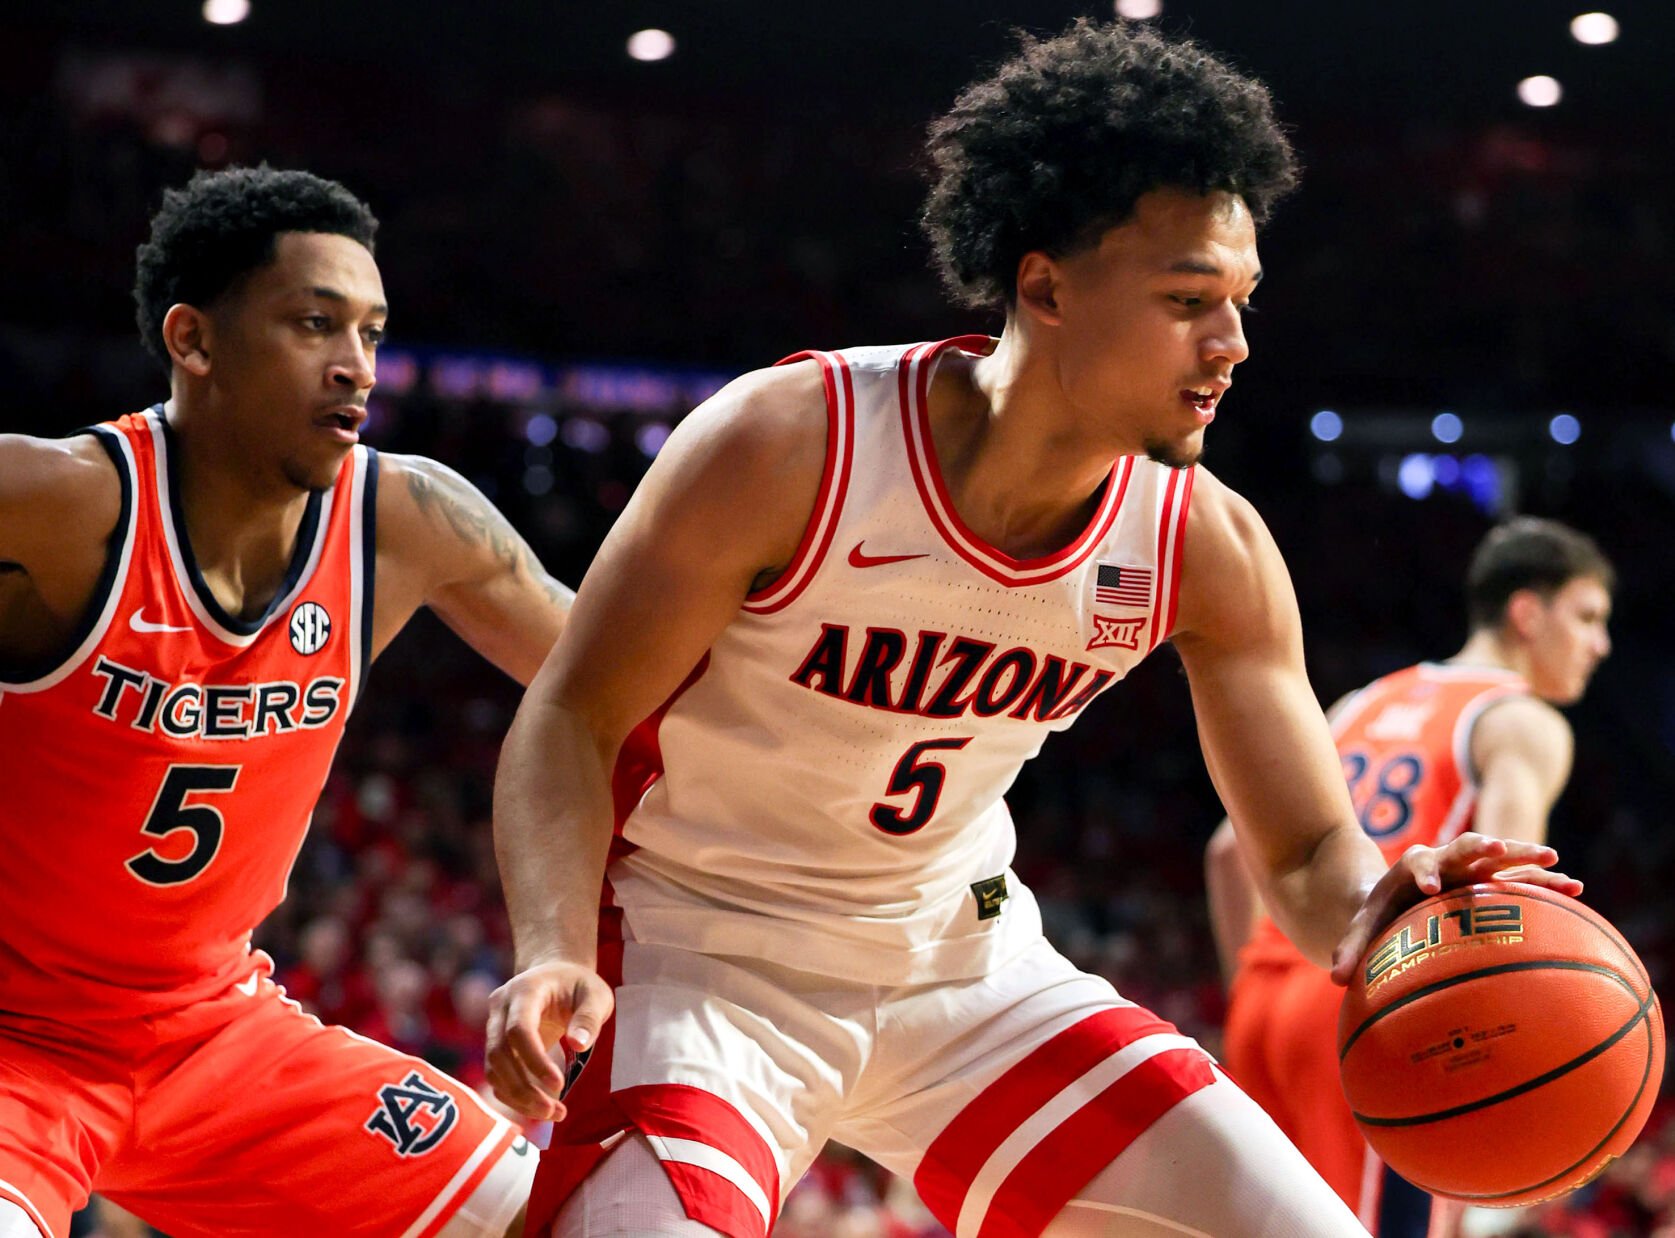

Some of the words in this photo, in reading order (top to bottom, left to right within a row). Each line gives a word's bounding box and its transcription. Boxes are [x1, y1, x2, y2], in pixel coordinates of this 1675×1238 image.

[290, 603, 331, 654] SEC
[789, 623, 1115, 722] ARIZONA
[1088, 616, 1145, 649] XII
[92, 655, 345, 740] TIGERS
[124, 764, 243, 887] 5
[869, 736, 975, 836] 5
